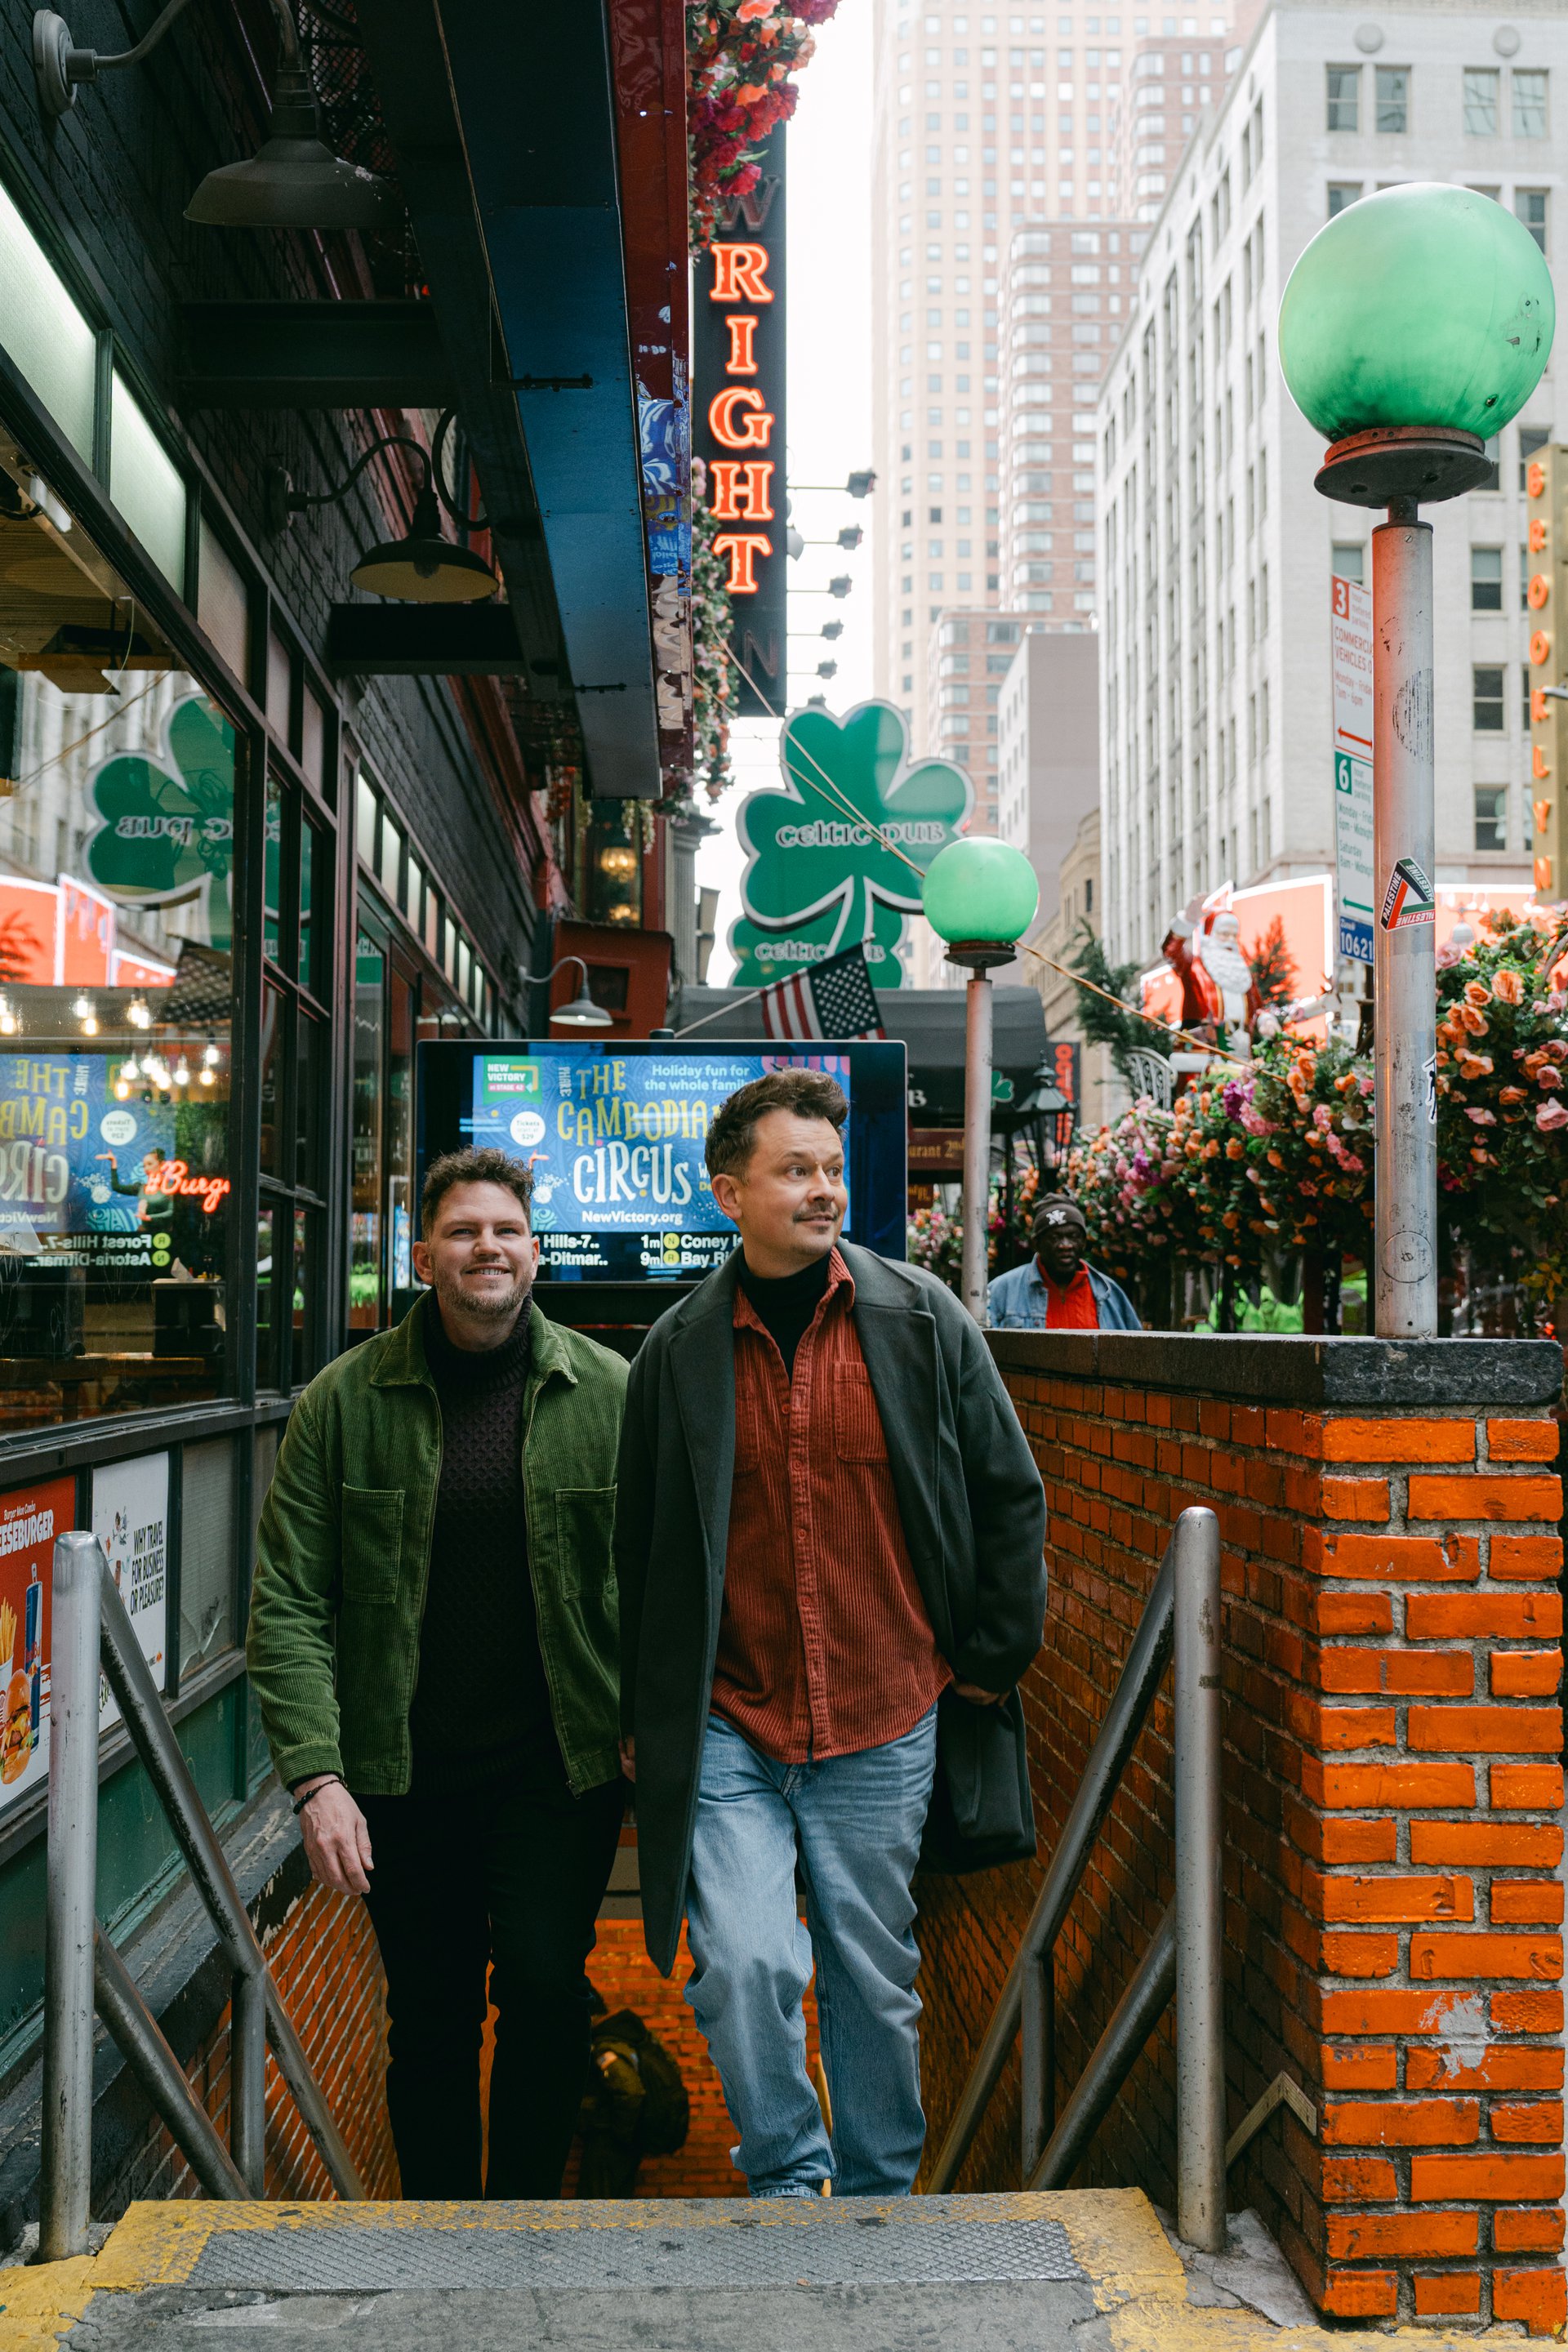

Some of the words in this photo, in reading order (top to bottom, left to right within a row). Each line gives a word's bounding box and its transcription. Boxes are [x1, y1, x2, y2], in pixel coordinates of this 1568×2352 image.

[1335, 581, 1346, 615] 3
[1334, 644, 1366, 671] VEHICLES
[1334, 669, 1354, 689] Monday
[1527, 463, 1551, 892] BROOKLYN
[1339, 759, 1349, 791] 6
[1339, 839, 1362, 858] Saturday
[1383, 871, 1401, 921] PALESTINE
[1340, 931, 1372, 960] 10621
[488, 1063, 510, 1072] NEW
[488, 1073, 526, 1082] VICTORY
[576, 1061, 626, 1100] THE
[652, 1064, 702, 1078] Holiday
[705, 1064, 727, 1076] fun
[730, 1064, 750, 1076] for
[644, 1079, 666, 1090] the
[669, 1079, 709, 1090] whole
[711, 1079, 747, 1090] famil
[557, 1097, 720, 1147] CAMBODIA
[573, 1141, 693, 1205] CIRCUS
[581, 1210, 684, 1225] NewVictory.org
[543, 1234, 599, 1249] Hills-7..
[641, 1234, 660, 1249] 1m
[680, 1234, 729, 1252] Coney
[640, 1251, 660, 1266] 9m
[680, 1251, 712, 1268] Bay
[134, 1526, 146, 1556] WHY
[147, 1520, 163, 1550] TRAVEL
[132, 1558, 142, 1586] FOR
[143, 1547, 163, 1581] BUSINESS
[131, 1588, 138, 1616] OR
[139, 1575, 164, 1611] PLEASURE?
